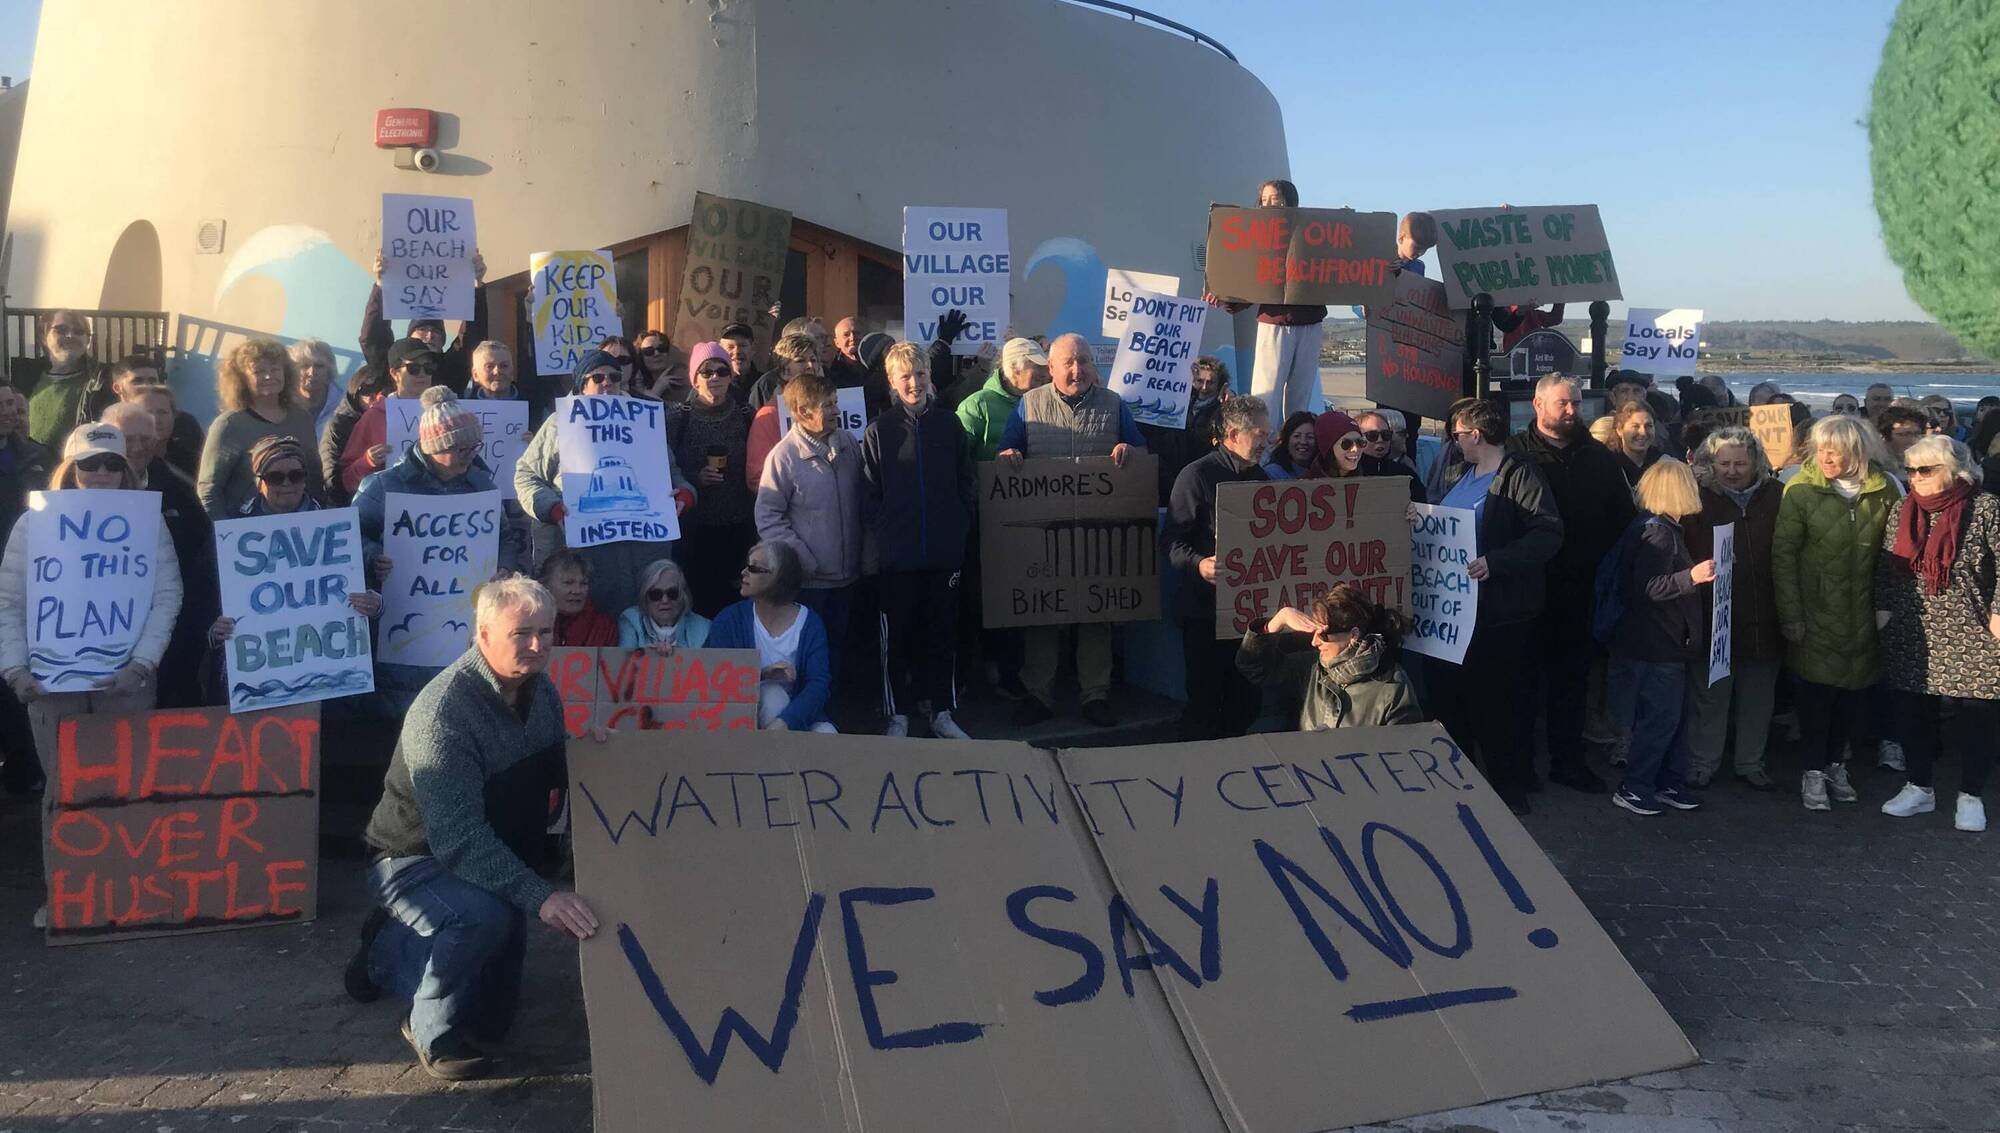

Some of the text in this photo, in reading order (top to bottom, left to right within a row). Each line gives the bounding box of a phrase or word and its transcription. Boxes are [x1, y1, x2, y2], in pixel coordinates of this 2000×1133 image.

[407, 207, 460, 234] OUR
[929, 222, 983, 241] OUR
[1220, 216, 1352, 252] SAVE OUR
[1441, 213, 1576, 251] WASTE OF
[391, 237, 464, 258] BEACH
[406, 263, 449, 280] OUR
[904, 254, 1010, 273] VILLAGE
[1256, 256, 1389, 288] BEACHFRONT
[1545, 251, 1616, 287] MONEY
[544, 263, 606, 296] KEEP
[690, 266, 772, 306] OUR
[400, 285, 448, 304] SAY
[552, 296, 600, 320] OUR
[932, 287, 984, 306] OUR
[1105, 305, 1128, 322] Sa
[1179, 304, 1205, 324] PUT
[551, 325, 608, 347] KIDS
[918, 322, 996, 341] VCE
[1154, 322, 1181, 339] OUR
[1628, 323, 1694, 340] Locals
[1128, 331, 1191, 360] BEACH
[1622, 341, 1695, 360] Say No
[1145, 357, 1177, 374] OUT
[1123, 372, 1187, 394] OF REACH
[570, 398, 660, 430] ADAPT
[1756, 408, 1786, 426] OUR
[506, 422, 521, 436] OF
[585, 425, 633, 444] THIS
[990, 472, 1114, 501] ARDMORE'S
[392, 509, 495, 538] ACCESS
[1249, 483, 1360, 539] SOS!
[60, 510, 131, 543] NO
[580, 520, 669, 544] INSTEAD
[234, 521, 352, 576] SAVE
[422, 545, 469, 565] FOR
[1438, 545, 1469, 566] OUR
[34, 555, 63, 583] TO
[1225, 540, 1388, 588] SAVE OUR
[409, 575, 464, 597] ALL
[1411, 564, 1471, 594] BEACH
[250, 573, 349, 616] OUR
[1012, 584, 1143, 616] BIKE SHED
[1411, 591, 1462, 617] OUT OF
[36, 596, 134, 642] PLAN
[1412, 614, 1459, 645] REACH
[234, 616, 371, 673] BEACH
[57, 712, 320, 804] HEART
[579, 736, 1476, 845] WATER ACTIVITY CENTER?
[51, 797, 265, 868] OVER
[53, 861, 306, 929] HUSTLE
[617, 801, 1559, 1087] WE SAY NO!
